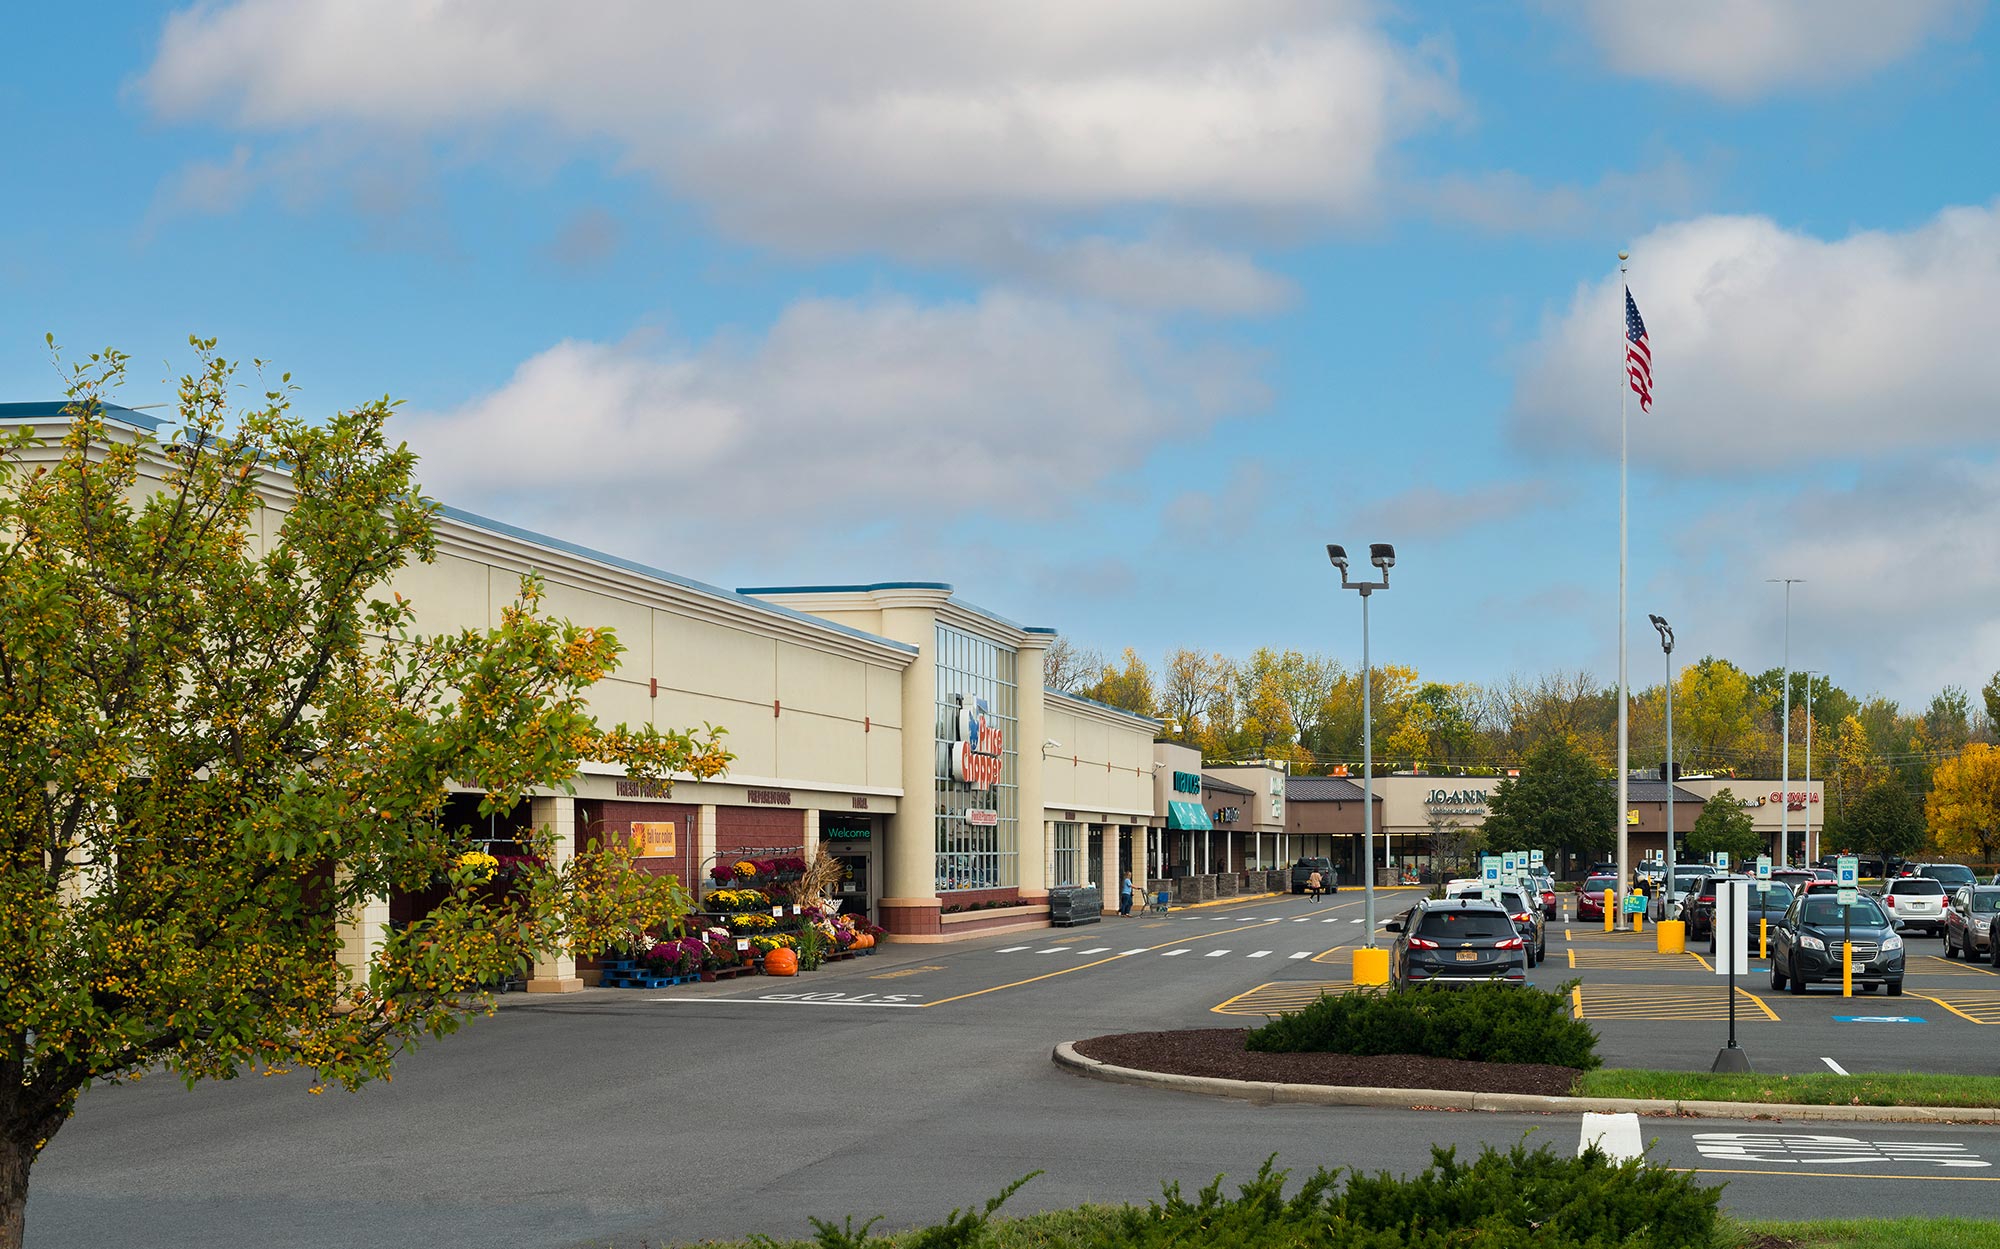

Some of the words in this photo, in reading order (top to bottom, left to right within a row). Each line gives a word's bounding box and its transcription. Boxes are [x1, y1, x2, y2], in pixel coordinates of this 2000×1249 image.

[979, 714, 1003, 756] Price
[961, 740, 1002, 791] Chopper
[616, 781, 639, 797] FRESH
[827, 827, 871, 838] Welcome
[758, 991, 923, 1003] STOP
